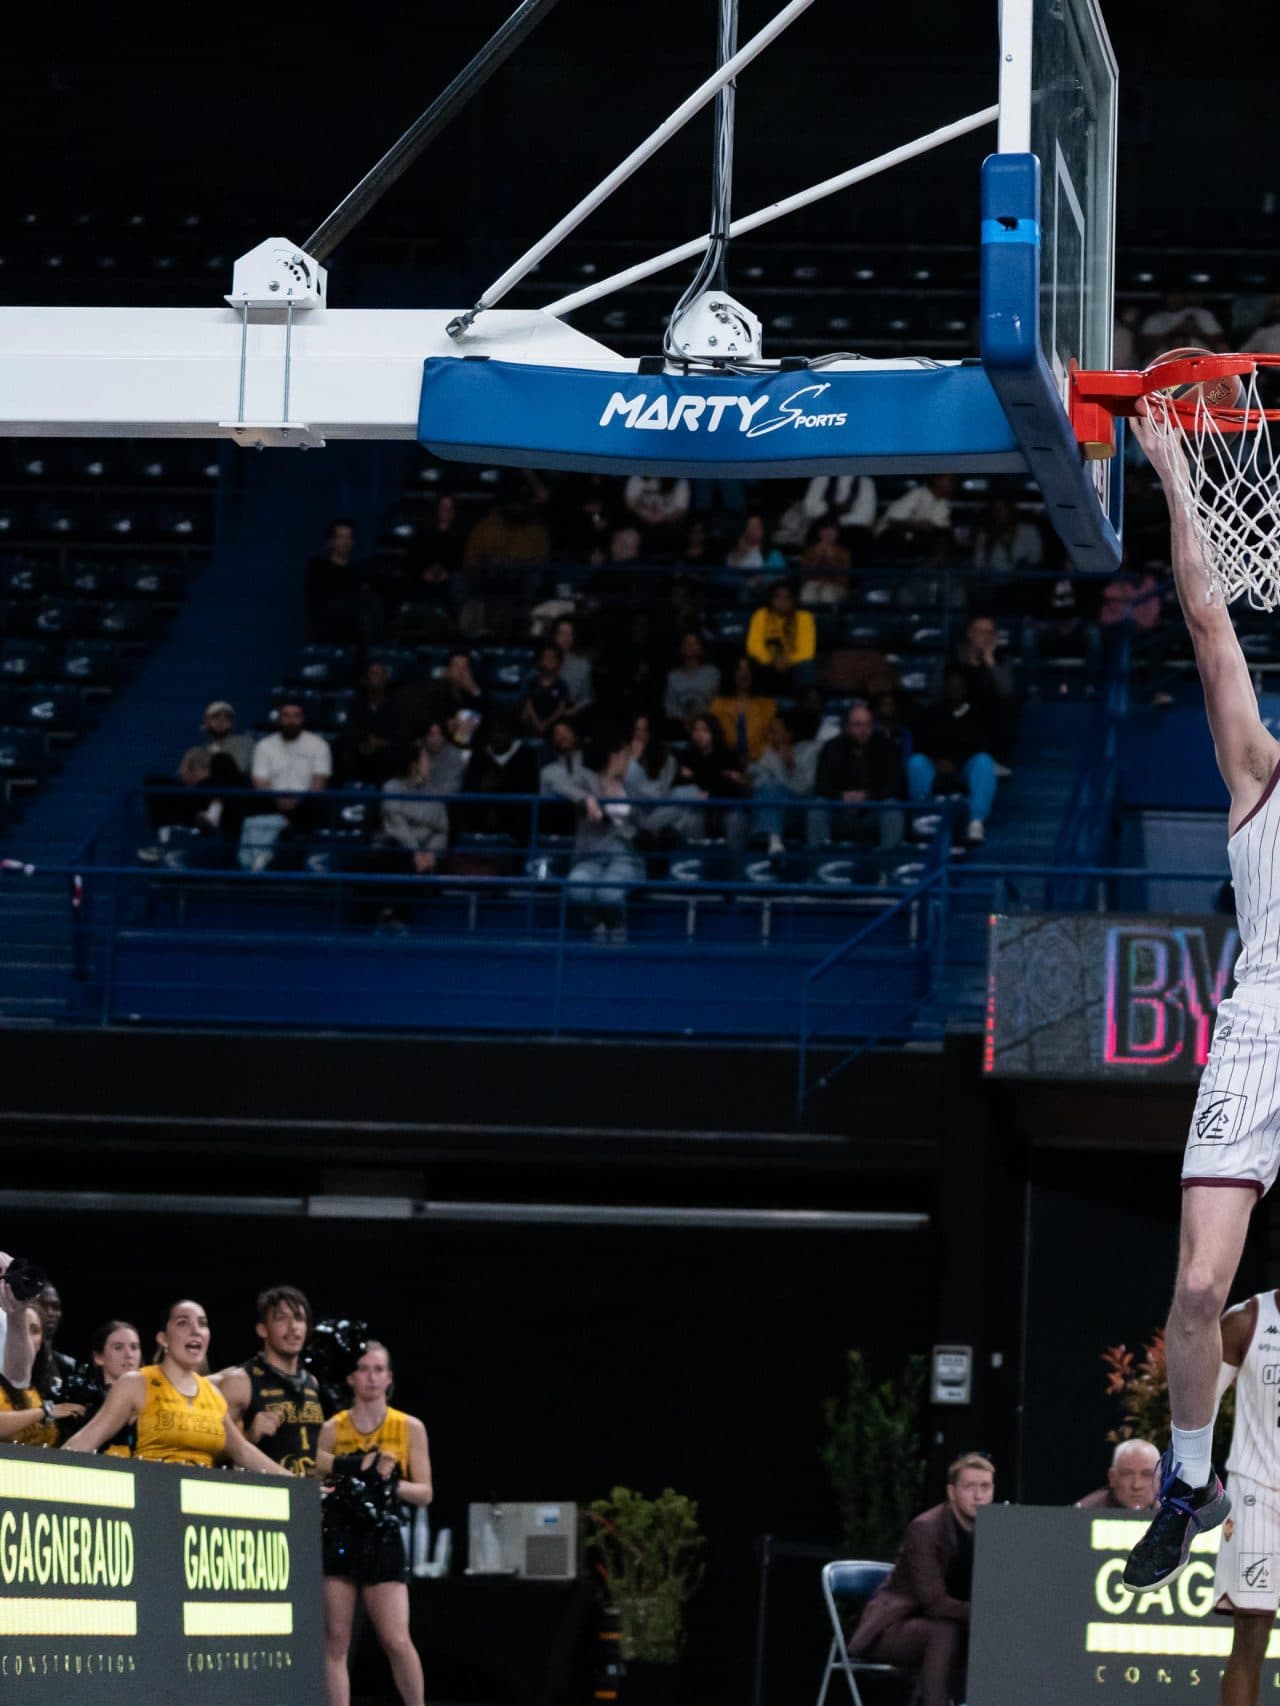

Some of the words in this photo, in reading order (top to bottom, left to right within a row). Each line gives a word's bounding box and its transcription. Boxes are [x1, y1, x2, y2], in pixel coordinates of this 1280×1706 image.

[599, 391, 769, 433] MARTY
[0, 1510, 136, 1588] GAGNERAUD
[183, 1525, 290, 1591] GAGNERAUD
[2, 1654, 136, 1676] CONSTRUCTION
[186, 1651, 293, 1673] CONSTRUCTION
